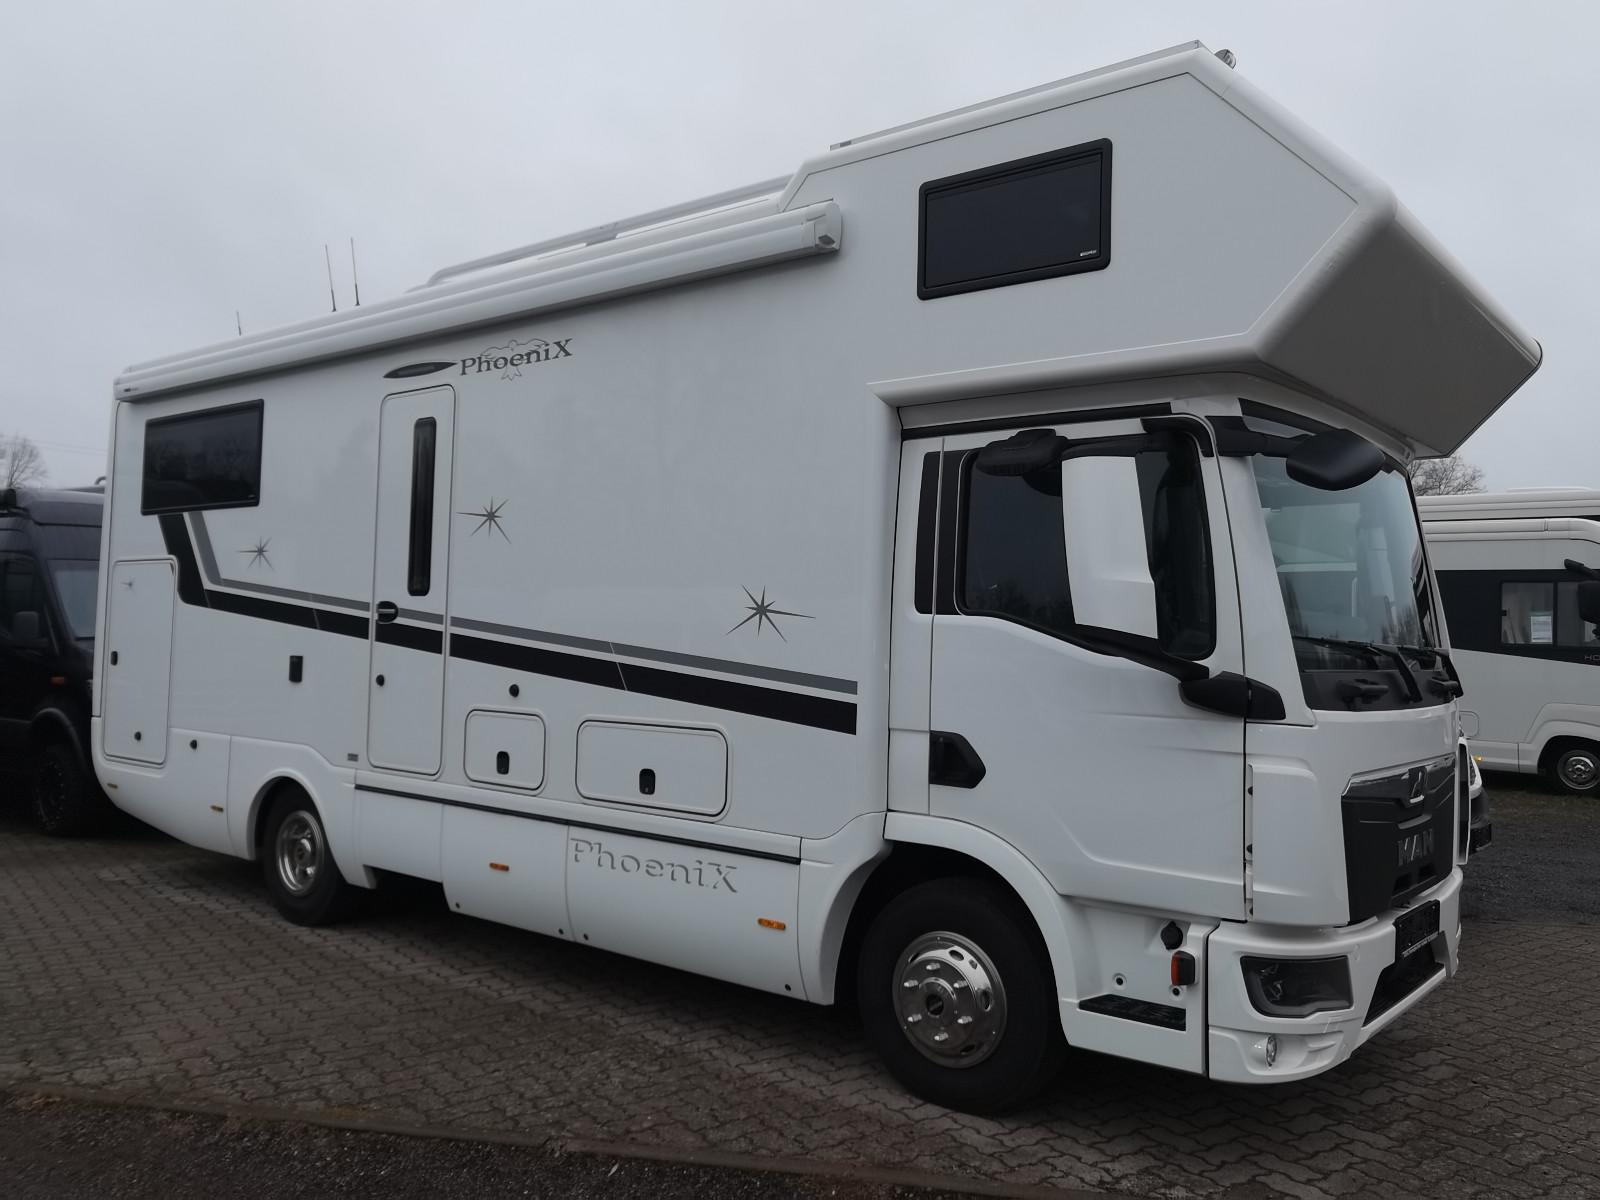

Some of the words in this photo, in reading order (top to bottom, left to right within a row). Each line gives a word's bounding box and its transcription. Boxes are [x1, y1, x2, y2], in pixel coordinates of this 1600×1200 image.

[460, 338, 573, 376] PhoeniX
[570, 837, 738, 893] PhoeniX
[1397, 828, 1434, 866] MAN
